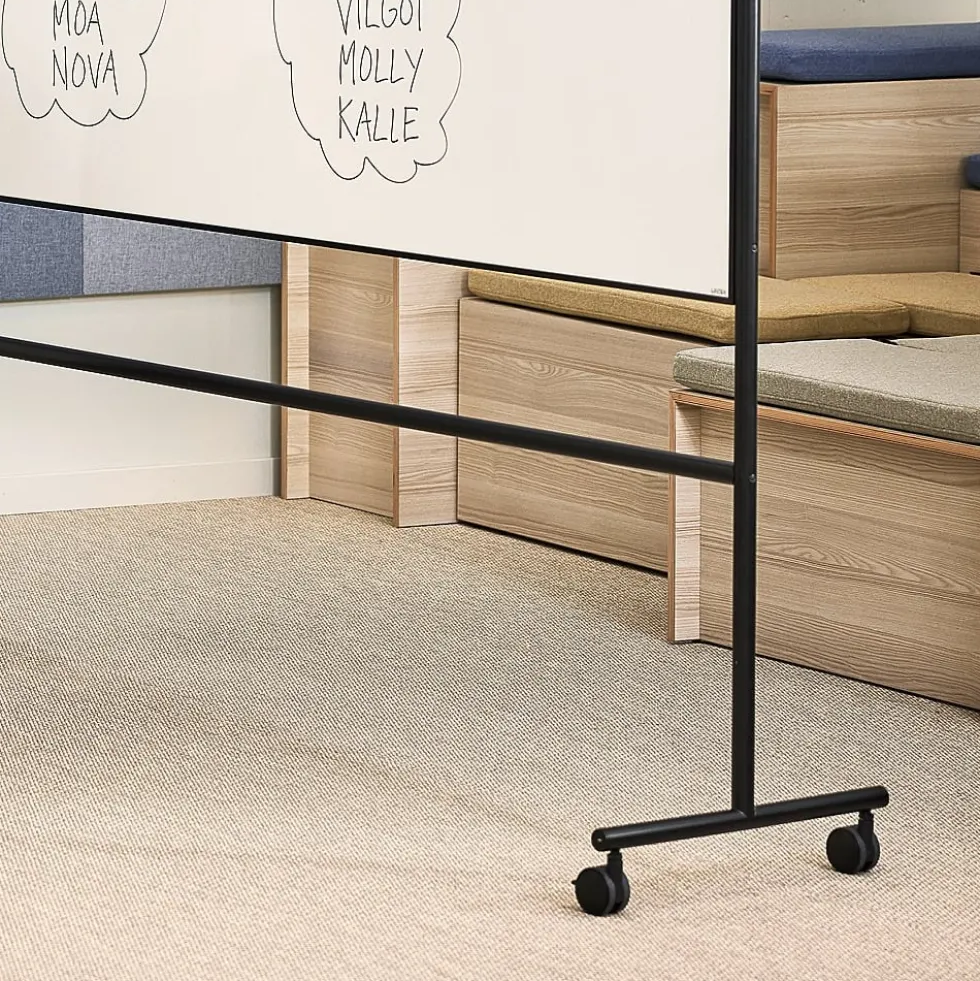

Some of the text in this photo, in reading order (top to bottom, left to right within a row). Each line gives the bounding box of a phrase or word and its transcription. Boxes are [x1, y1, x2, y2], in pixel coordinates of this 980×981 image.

[51, 45, 119, 96] NOVA
[338, 39, 424, 94] MOLLY
[338, 95, 420, 144] KALLE
